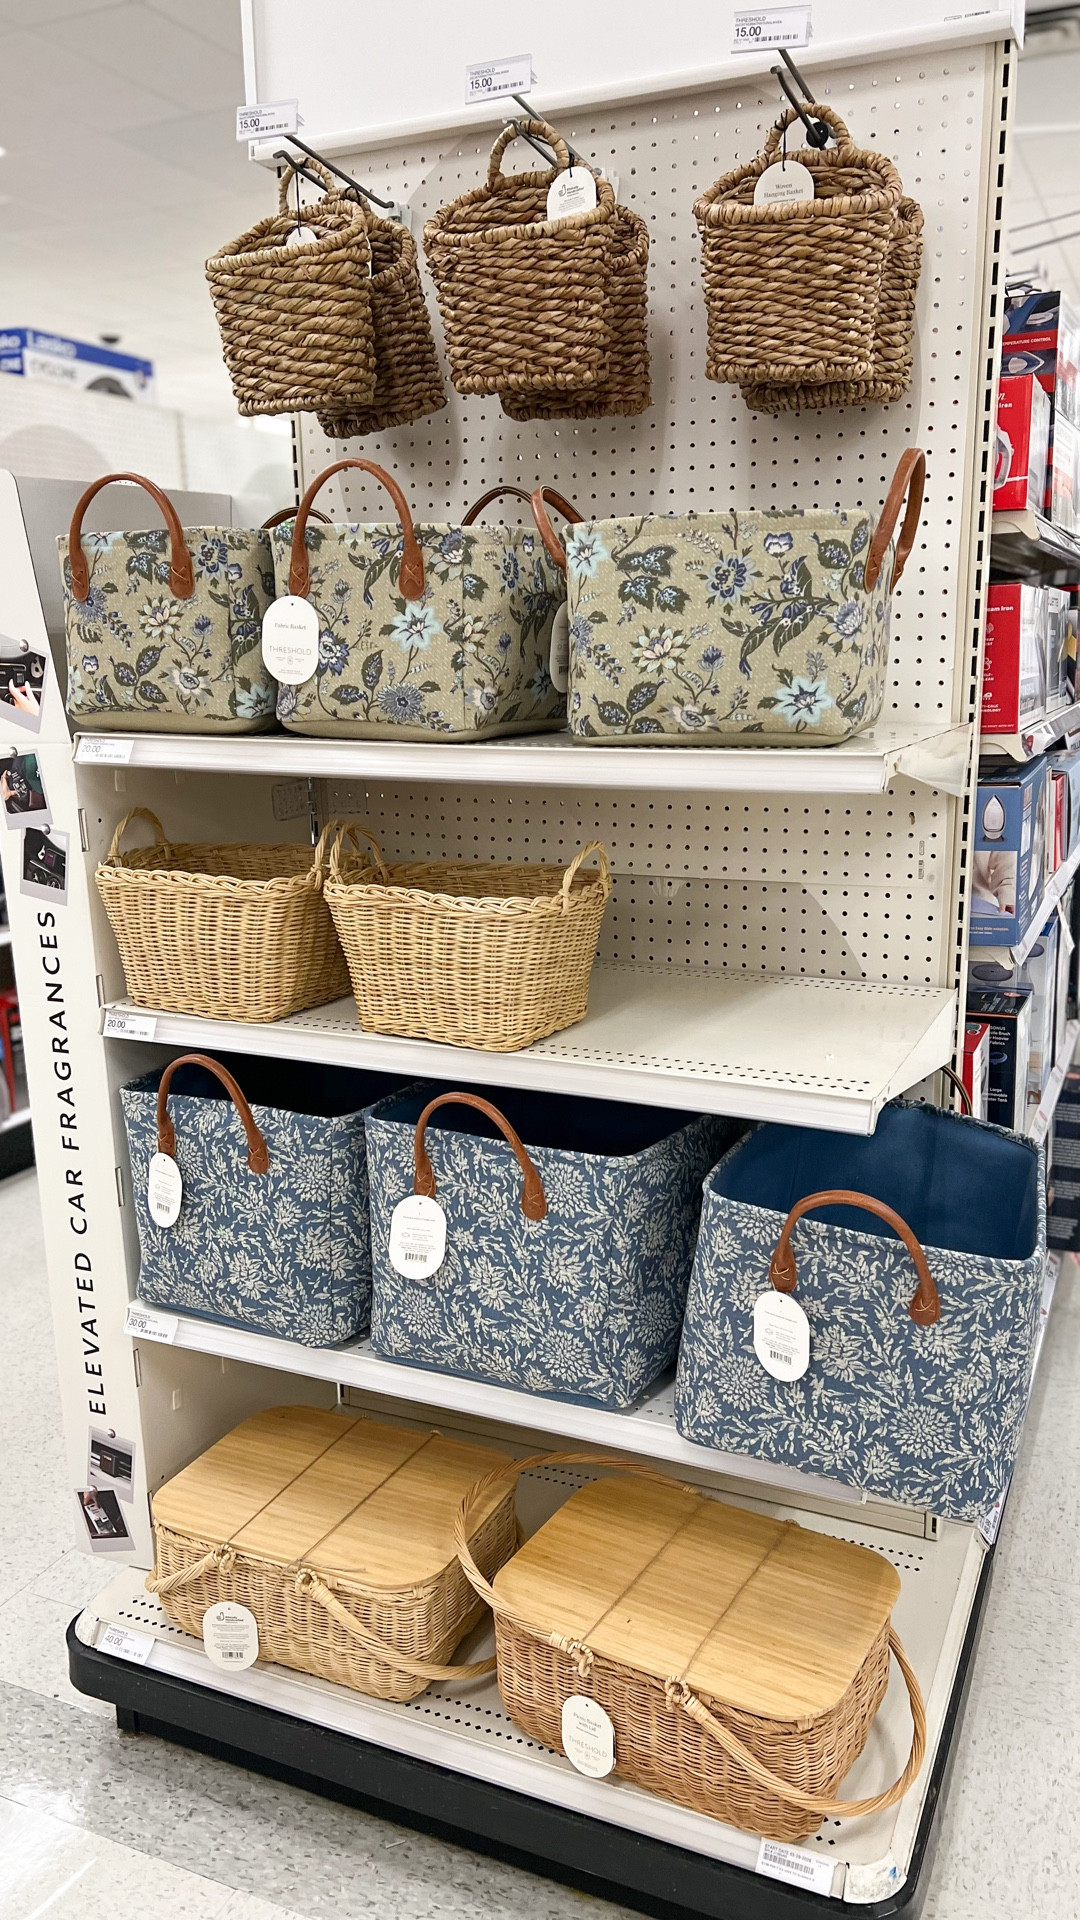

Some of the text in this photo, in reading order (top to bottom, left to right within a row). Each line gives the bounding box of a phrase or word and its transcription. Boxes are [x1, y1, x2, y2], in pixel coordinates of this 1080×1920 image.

[735, 26, 762, 37] 15.00
[470, 77, 493, 90] 15.00
[240, 118, 260, 129] 15.00
[269, 645, 312, 656] THRESHOLD
[82, 744, 101, 753] 20.00
[107, 1019, 126, 1029] 20.00
[37, 912, 107, 1416] ELEVATED CAR FRAGRANCES
[128, 1318, 147, 1329] 30.00
[105, 1634, 123, 1646] 40.00
[568, 1735, 608, 1758] THRESHOLD
[764, 1843, 778, 1852] START
